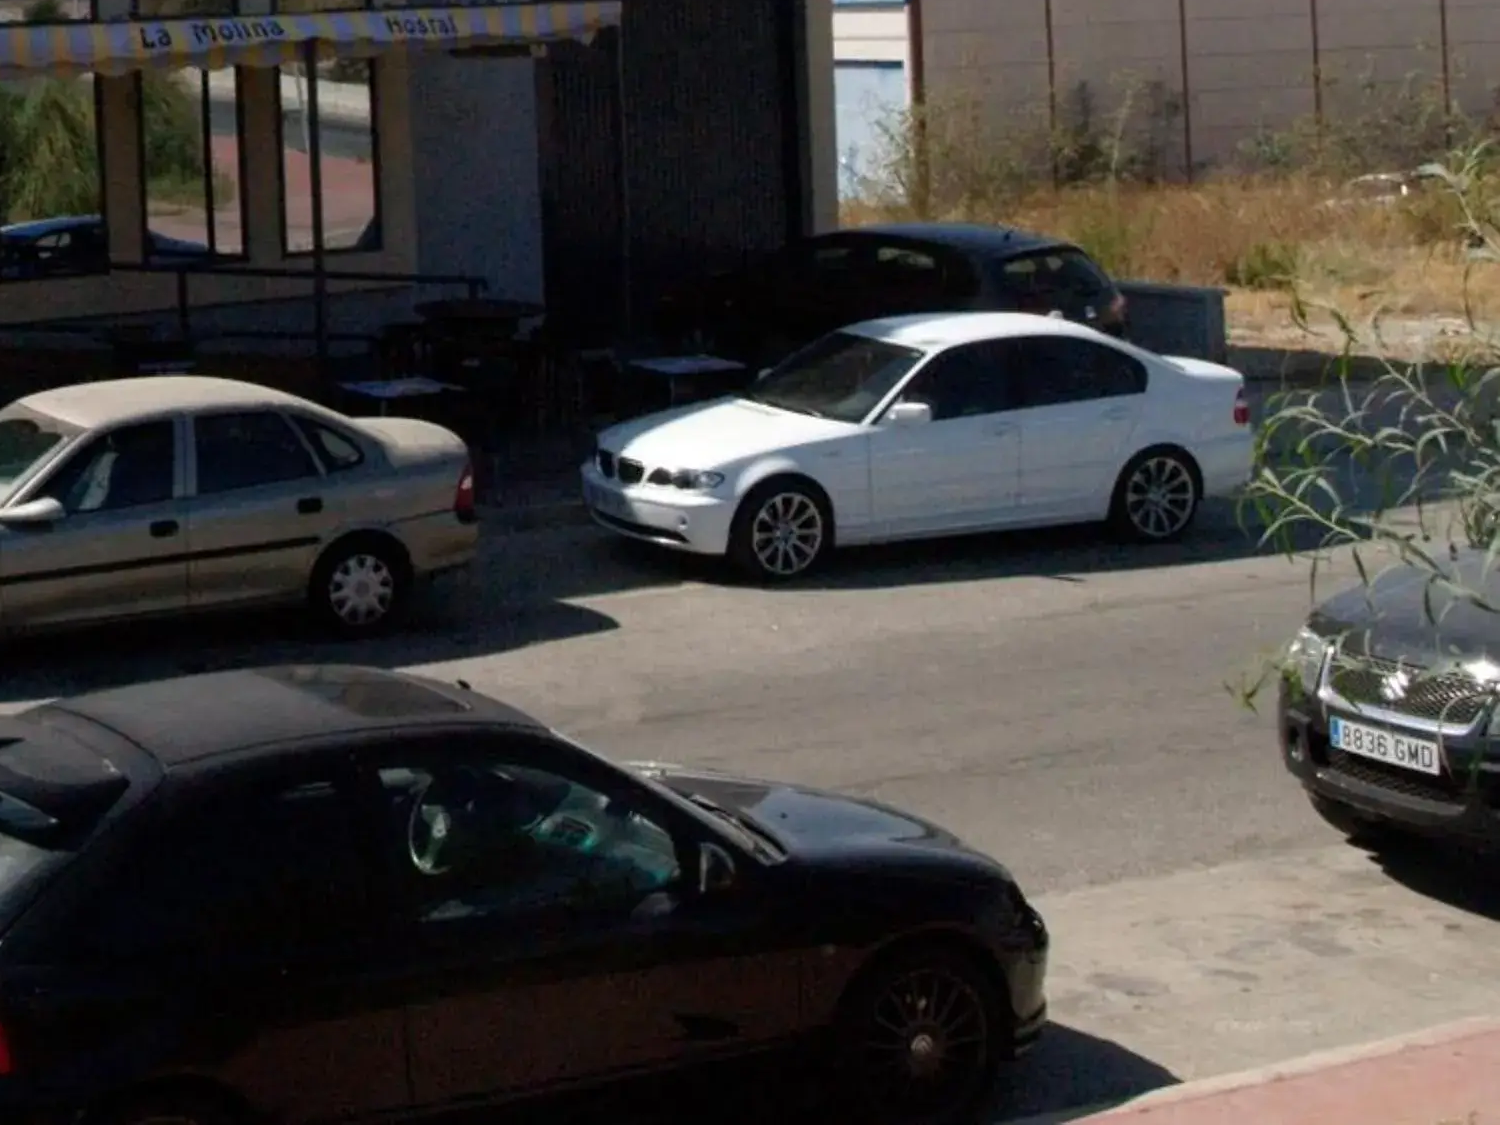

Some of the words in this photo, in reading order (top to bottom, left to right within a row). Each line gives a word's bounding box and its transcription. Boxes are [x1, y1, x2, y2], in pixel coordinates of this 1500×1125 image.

[140, 26, 173, 49] La
[191, 19, 286, 46] Molina
[385, 15, 459, 37] Hostal
